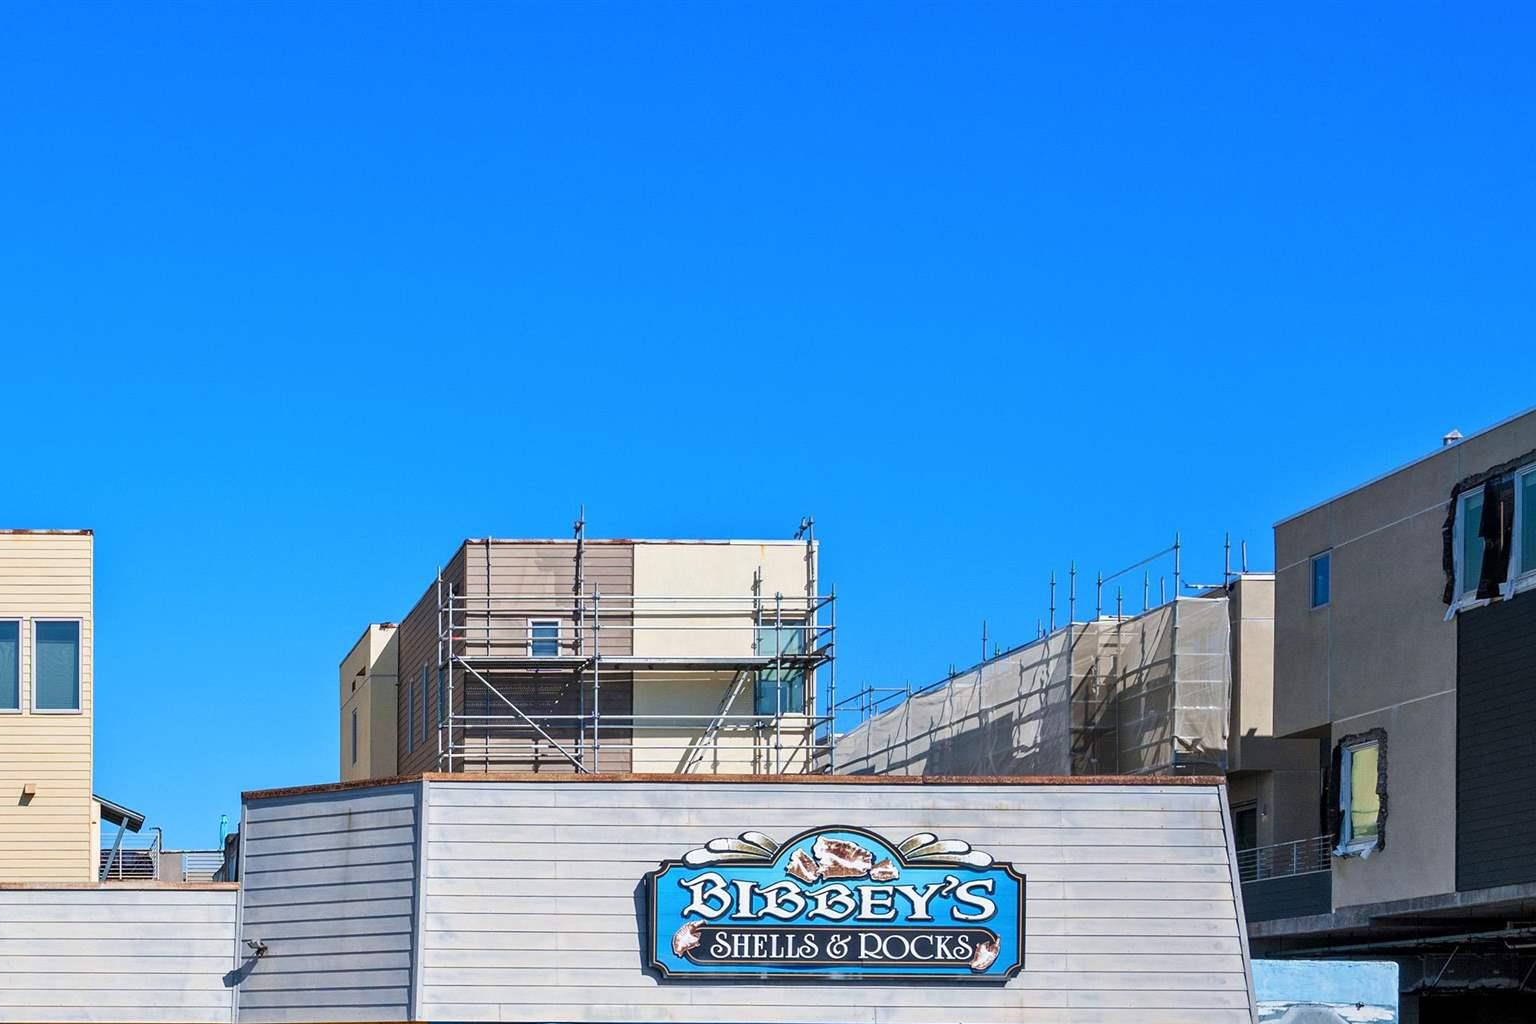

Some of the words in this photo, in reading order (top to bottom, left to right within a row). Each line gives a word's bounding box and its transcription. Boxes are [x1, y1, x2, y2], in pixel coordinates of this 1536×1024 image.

[681, 872, 997, 921] BIBBEY'S
[710, 931, 819, 959] SHELLS
[823, 934, 852, 959] &
[858, 932, 973, 960] ROCKS
